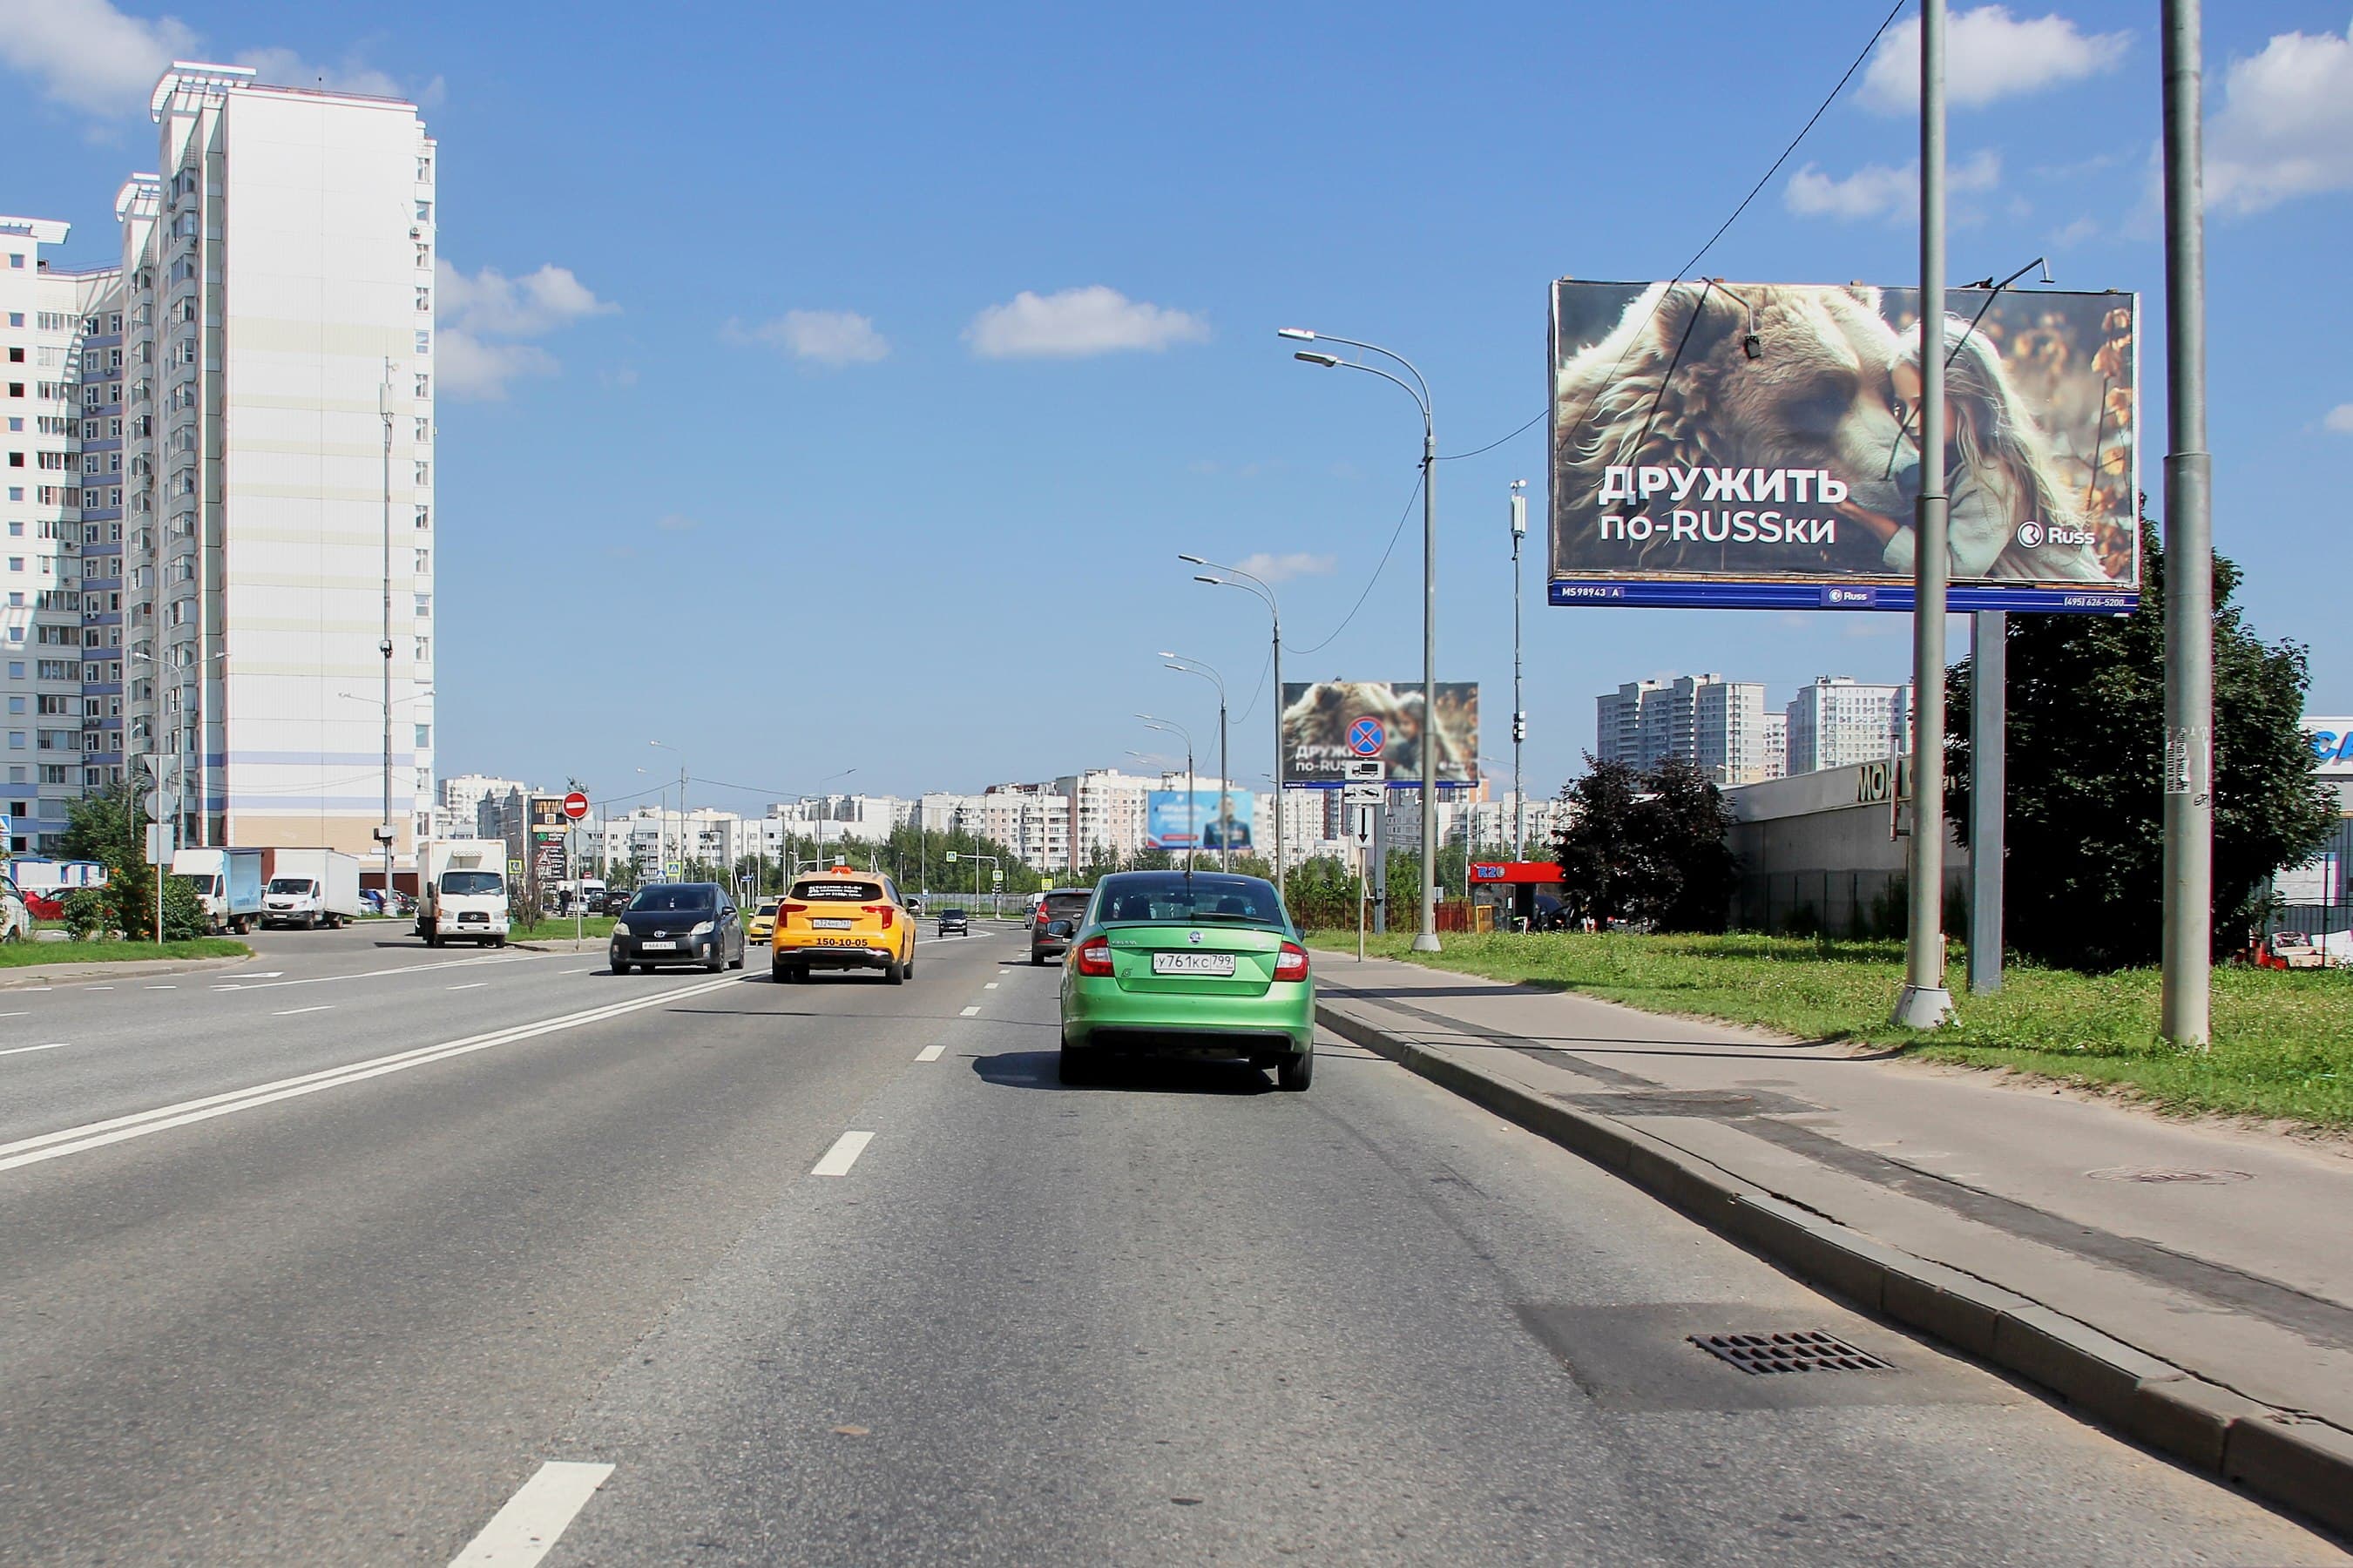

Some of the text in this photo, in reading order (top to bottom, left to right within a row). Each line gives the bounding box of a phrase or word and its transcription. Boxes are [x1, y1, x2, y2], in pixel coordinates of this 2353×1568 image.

[1598, 466, 1848, 505] ДРУЖИТЬ
[1600, 510, 1835, 544] по-RUSSки
[2048, 527, 2095, 544] Russ
[1843, 591, 1868, 600] Russ
[2064, 597, 2125, 606] (495) 626-5200
[1212, 955, 1231, 965] 799
